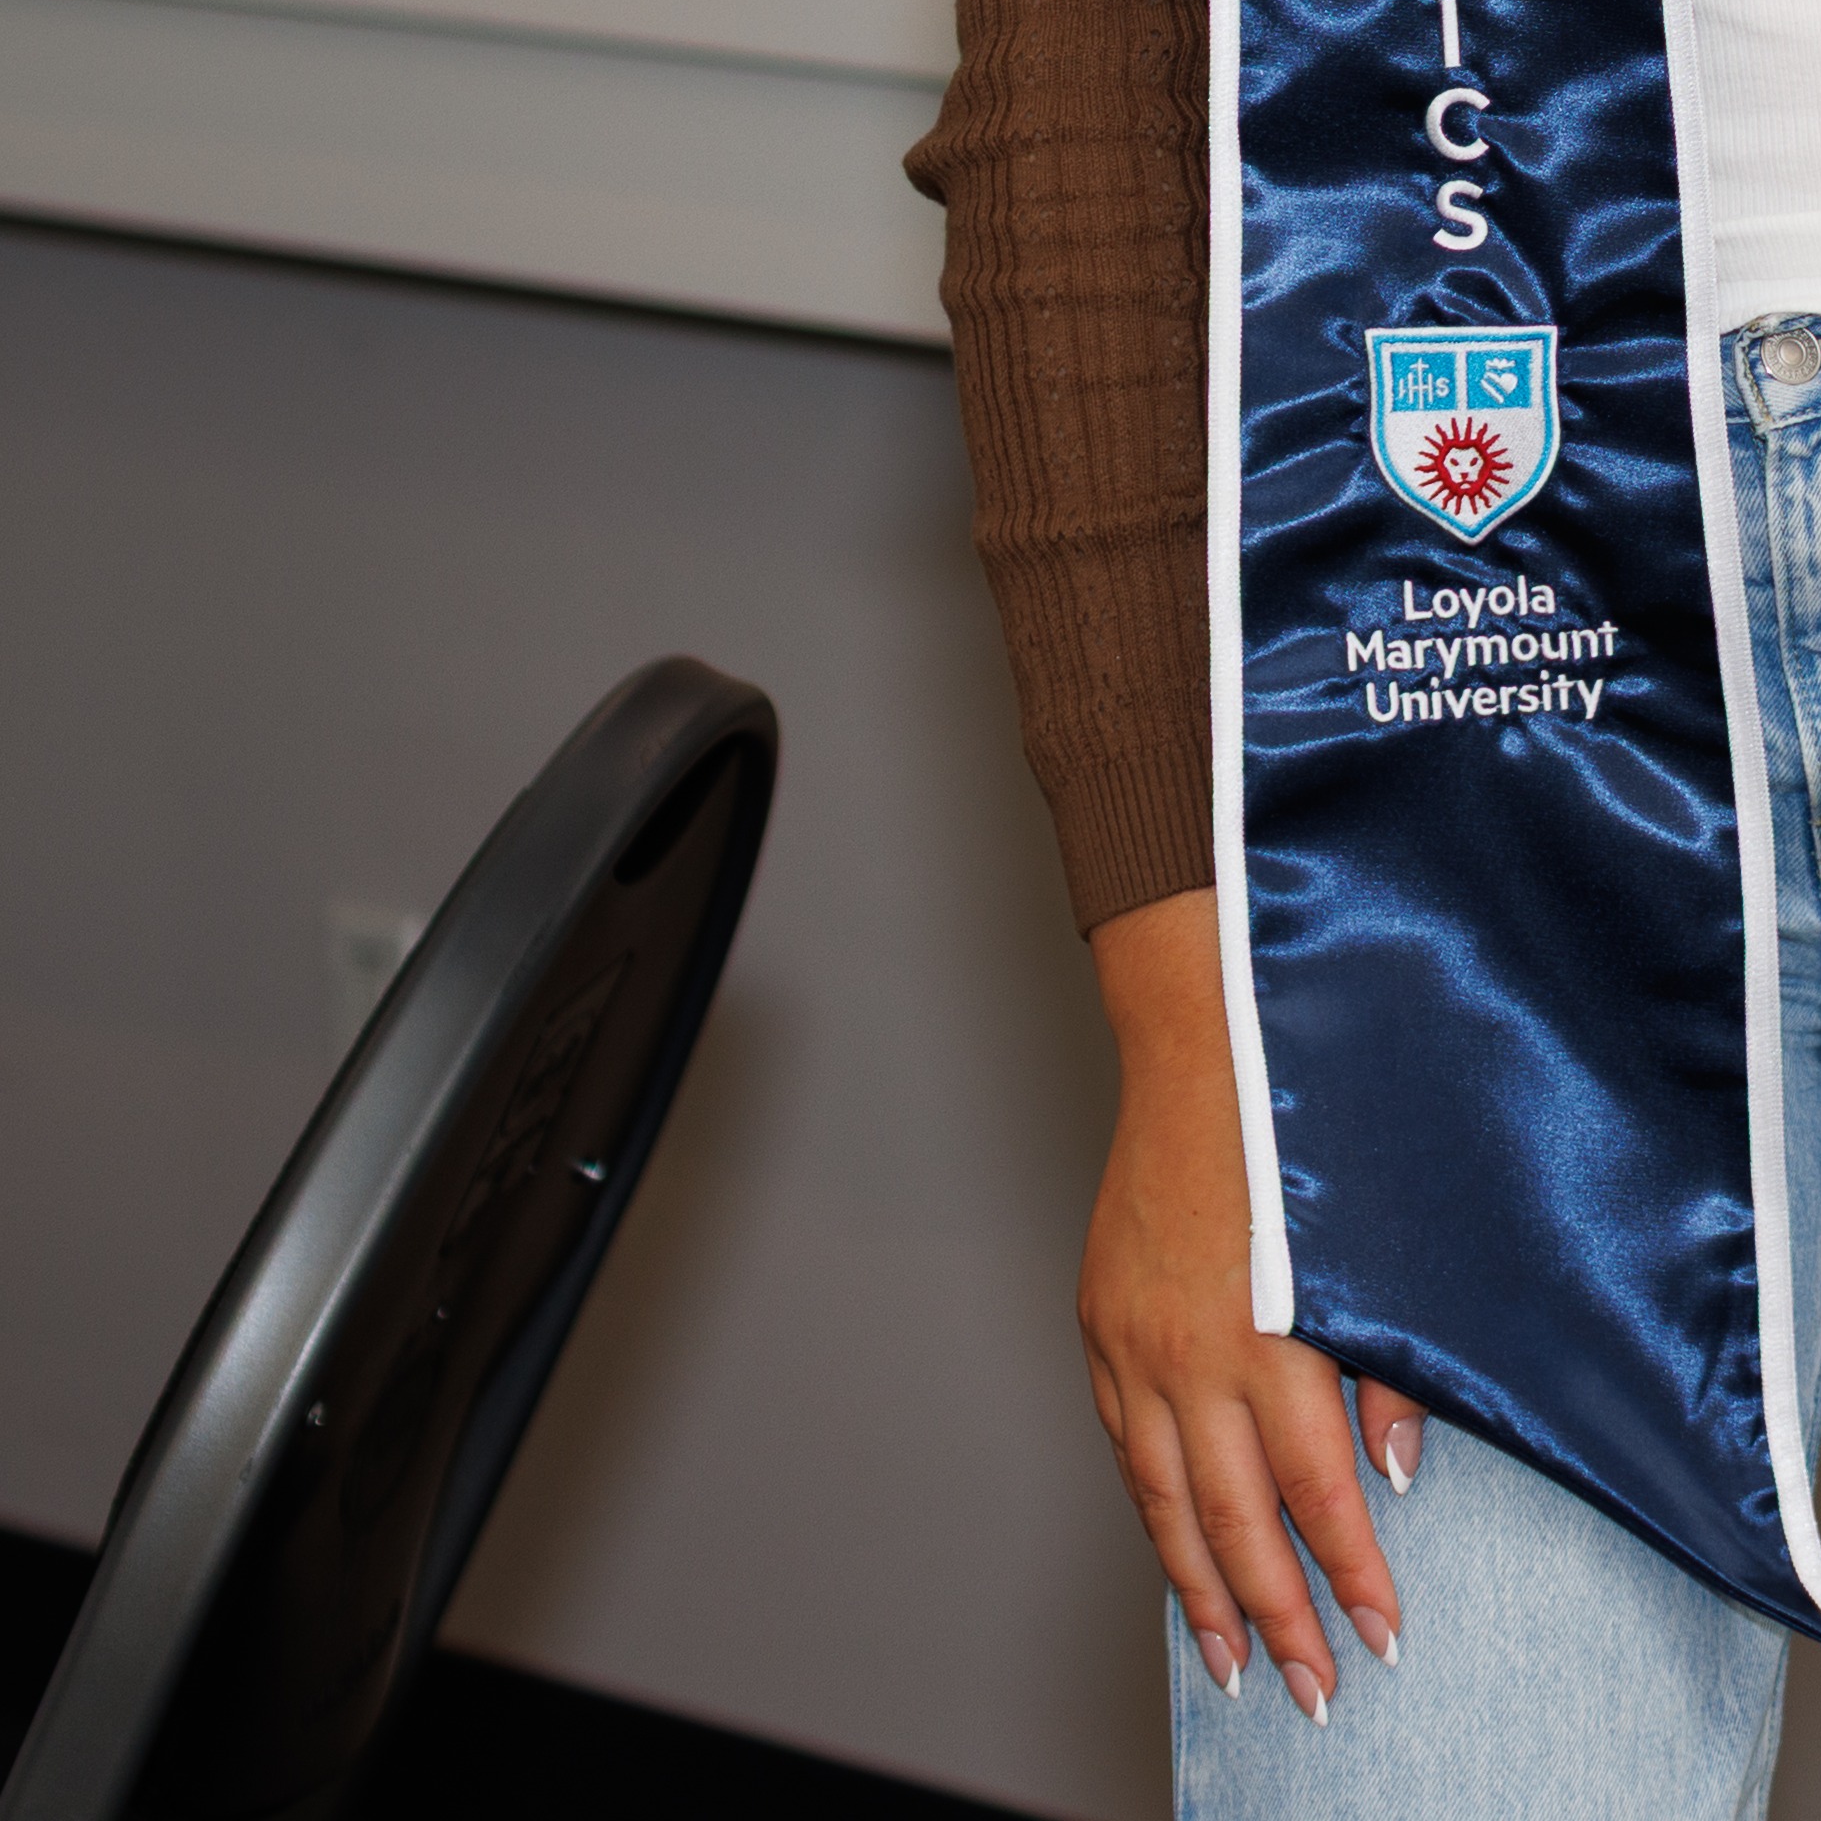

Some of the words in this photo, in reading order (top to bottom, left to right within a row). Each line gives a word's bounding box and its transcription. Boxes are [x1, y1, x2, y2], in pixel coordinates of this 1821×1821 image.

[1402, 574, 1557, 629] Loyola
[1345, 620, 1620, 681] Marymount
[1365, 669, 1605, 723] University
